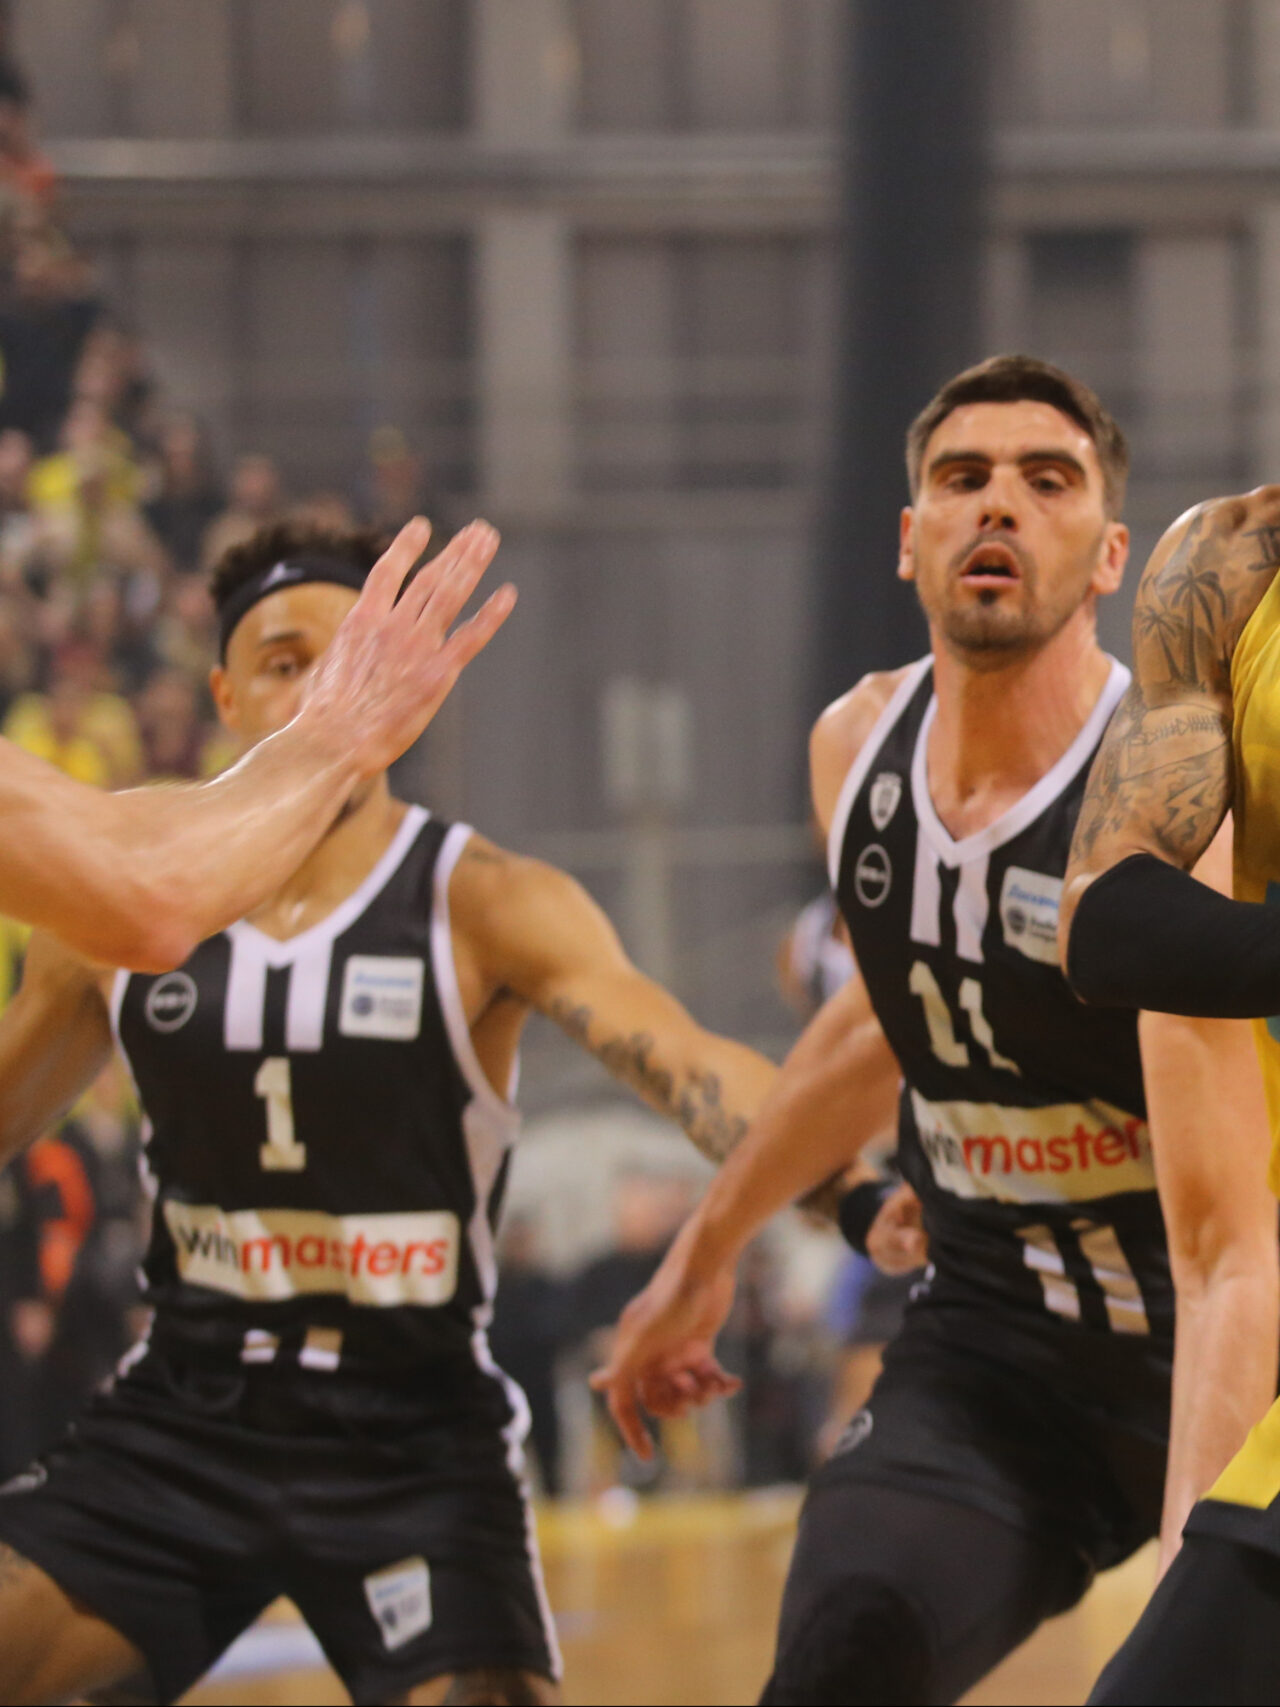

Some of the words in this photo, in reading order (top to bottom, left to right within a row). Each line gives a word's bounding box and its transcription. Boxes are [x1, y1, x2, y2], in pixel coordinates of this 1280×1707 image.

[908, 960, 1022, 1077] 11
[254, 1056, 306, 1172] 1
[922, 1119, 1152, 1175] winmaster
